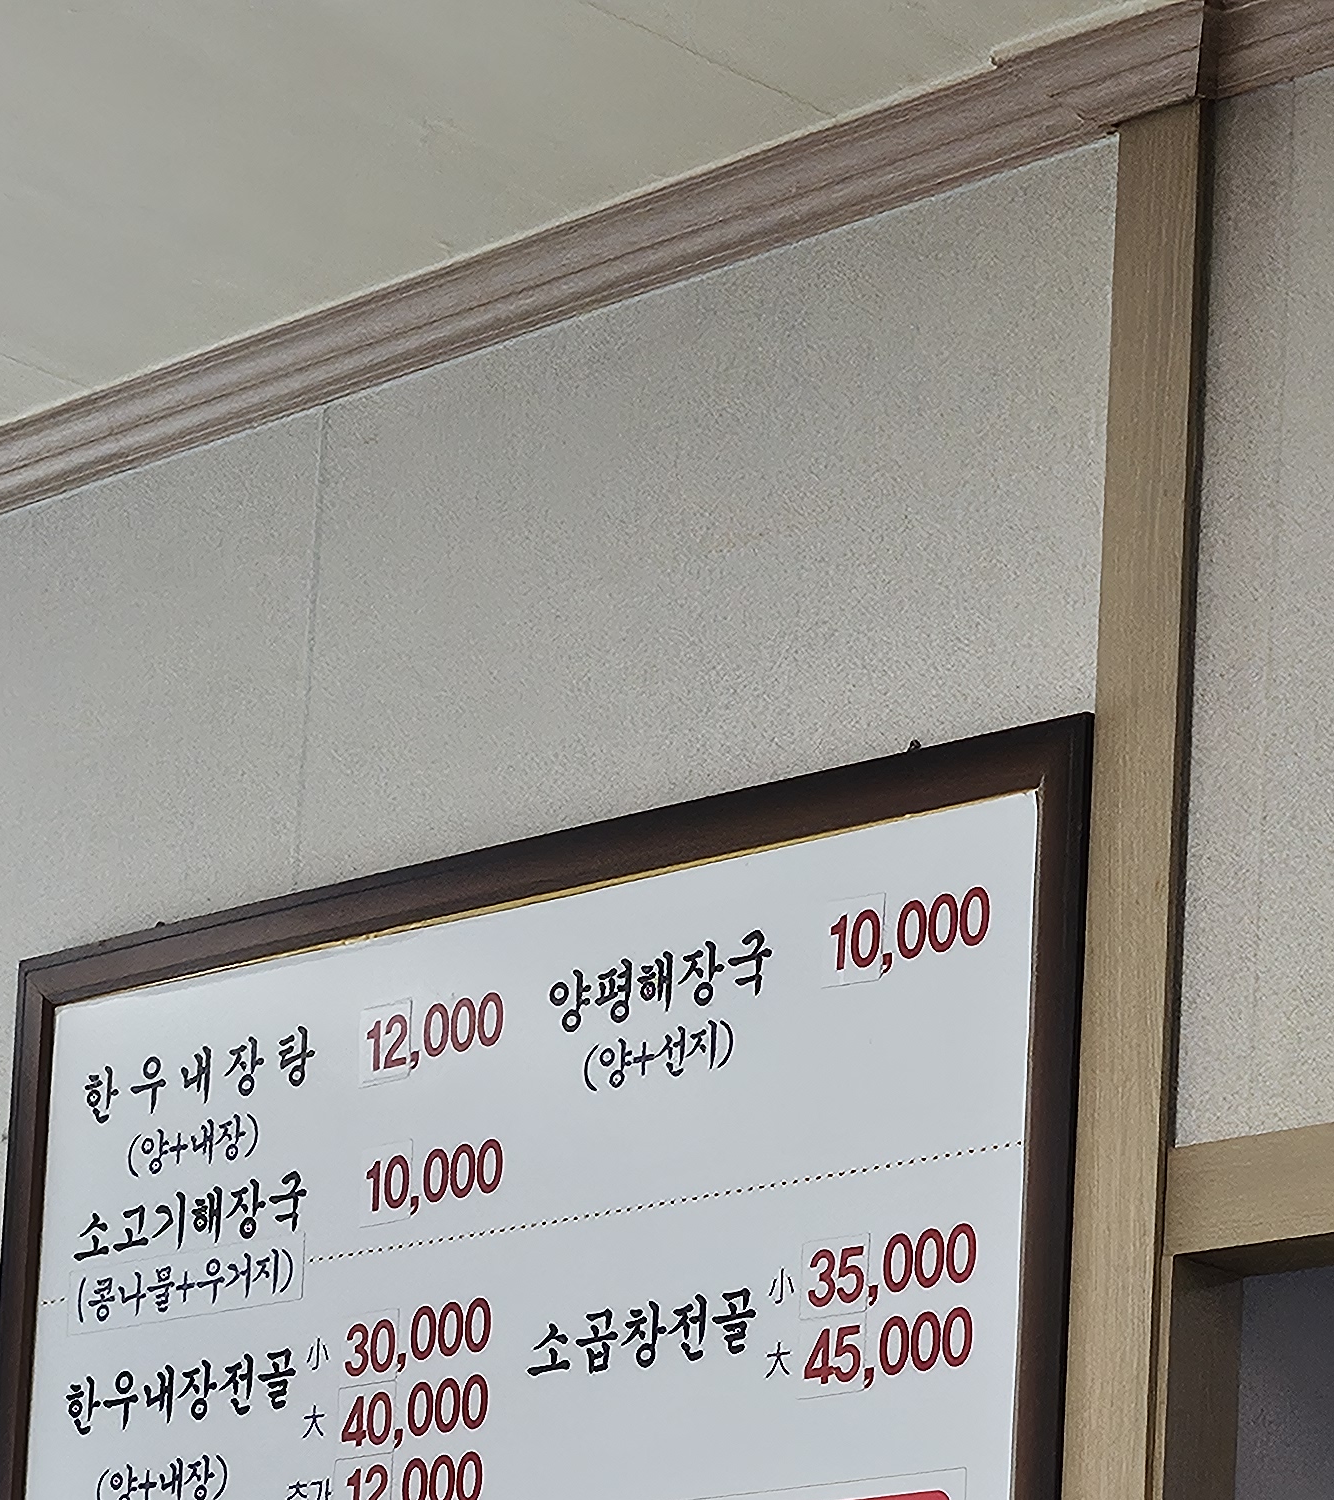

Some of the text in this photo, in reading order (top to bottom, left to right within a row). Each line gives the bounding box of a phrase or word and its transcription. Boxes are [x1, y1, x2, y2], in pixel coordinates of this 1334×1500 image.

[549, 886, 991, 1033] 양평해장국 10,000
[366, 991, 504, 1072] 12,000
[583, 1019, 734, 1092] (양+선지)
[127, 1113, 259, 1178] (양+내장)
[73, 1138, 504, 1262] 소고기해장국 10,000
[75, 1248, 295, 1324] (콩나물+우거지)
[807, 1222, 977, 1308] 35,000
[344, 1297, 492, 1377] 30,000
[526, 1287, 757, 1377] 소곱창전골
[765, 1306, 973, 1392] 大 45,000
[65, 1347, 297, 1436] 한우내장전골
[302, 1373, 489, 1452] 大 40,000
